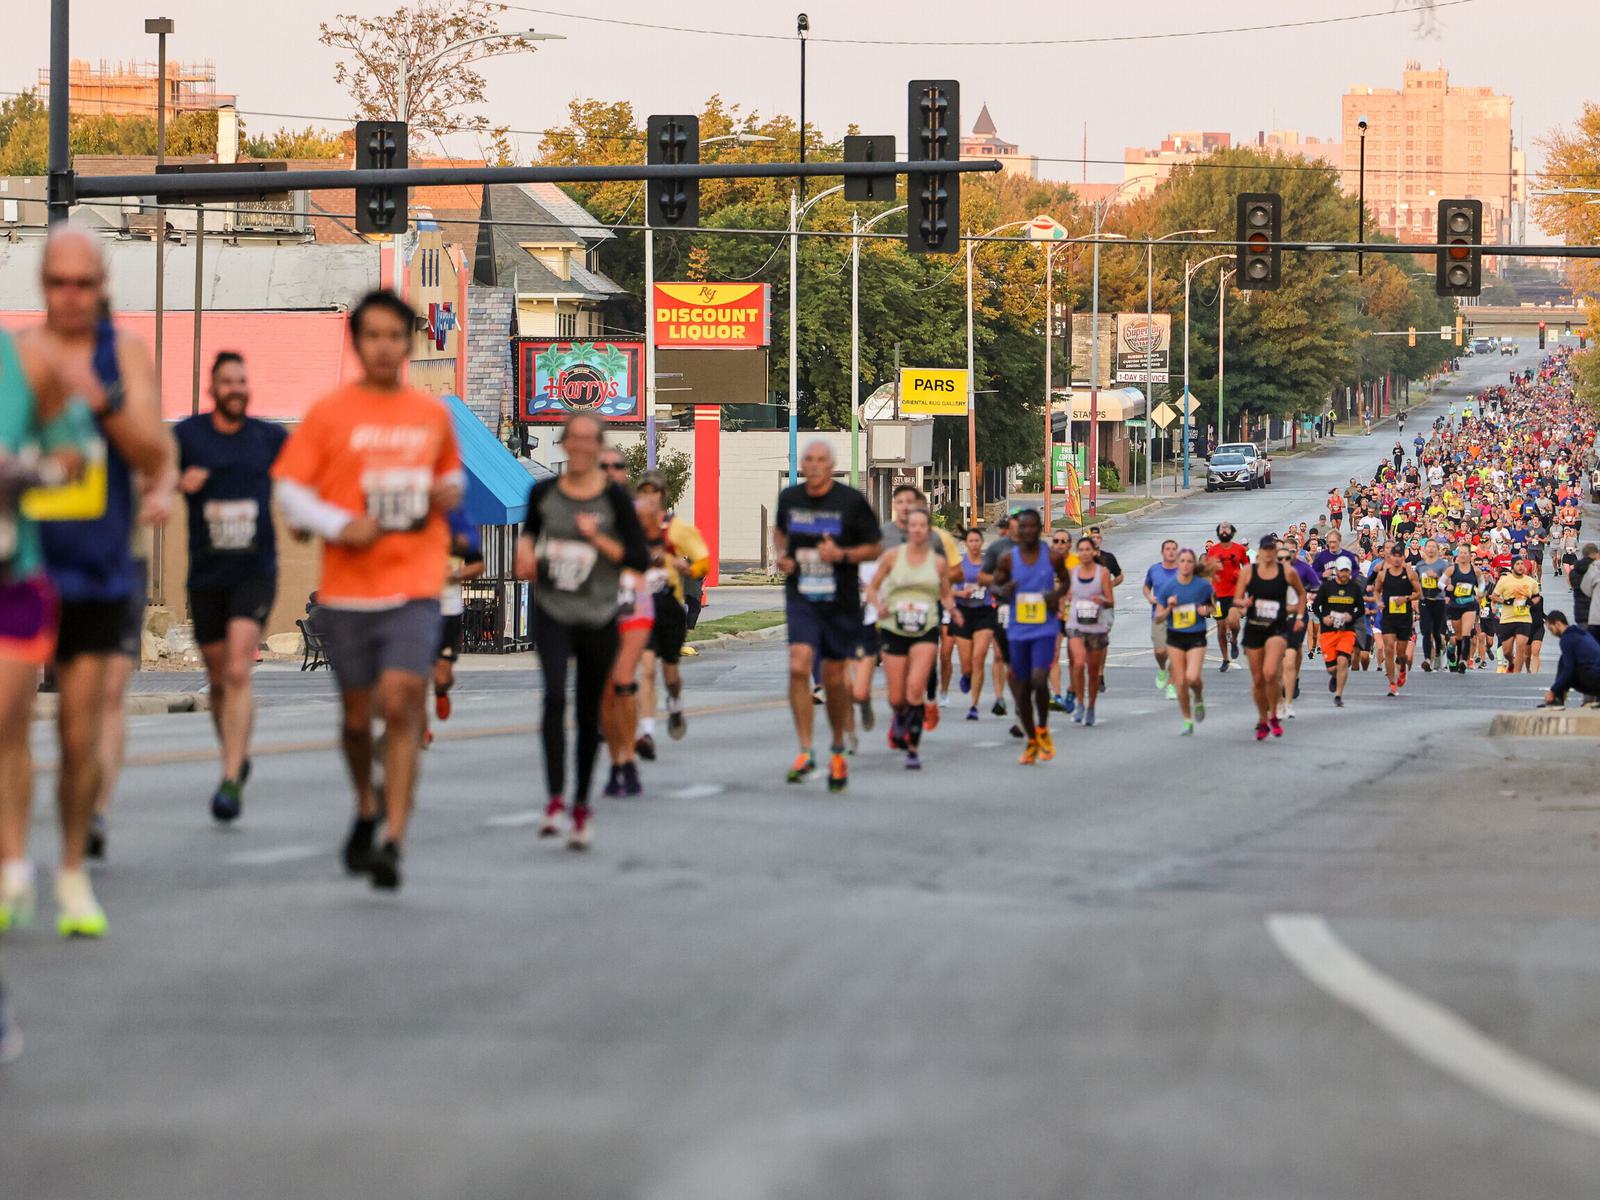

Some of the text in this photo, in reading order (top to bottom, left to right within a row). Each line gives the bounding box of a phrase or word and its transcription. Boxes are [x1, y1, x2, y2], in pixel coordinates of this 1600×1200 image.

[656, 308, 758, 323] DISCOUNT
[669, 325, 746, 340] LIQUOR
[1127, 326, 1160, 339] Superor
[914, 378, 955, 392] PARS
[1139, 374, 1167, 382] SEVICE
[543, 371, 619, 408] Harry's
